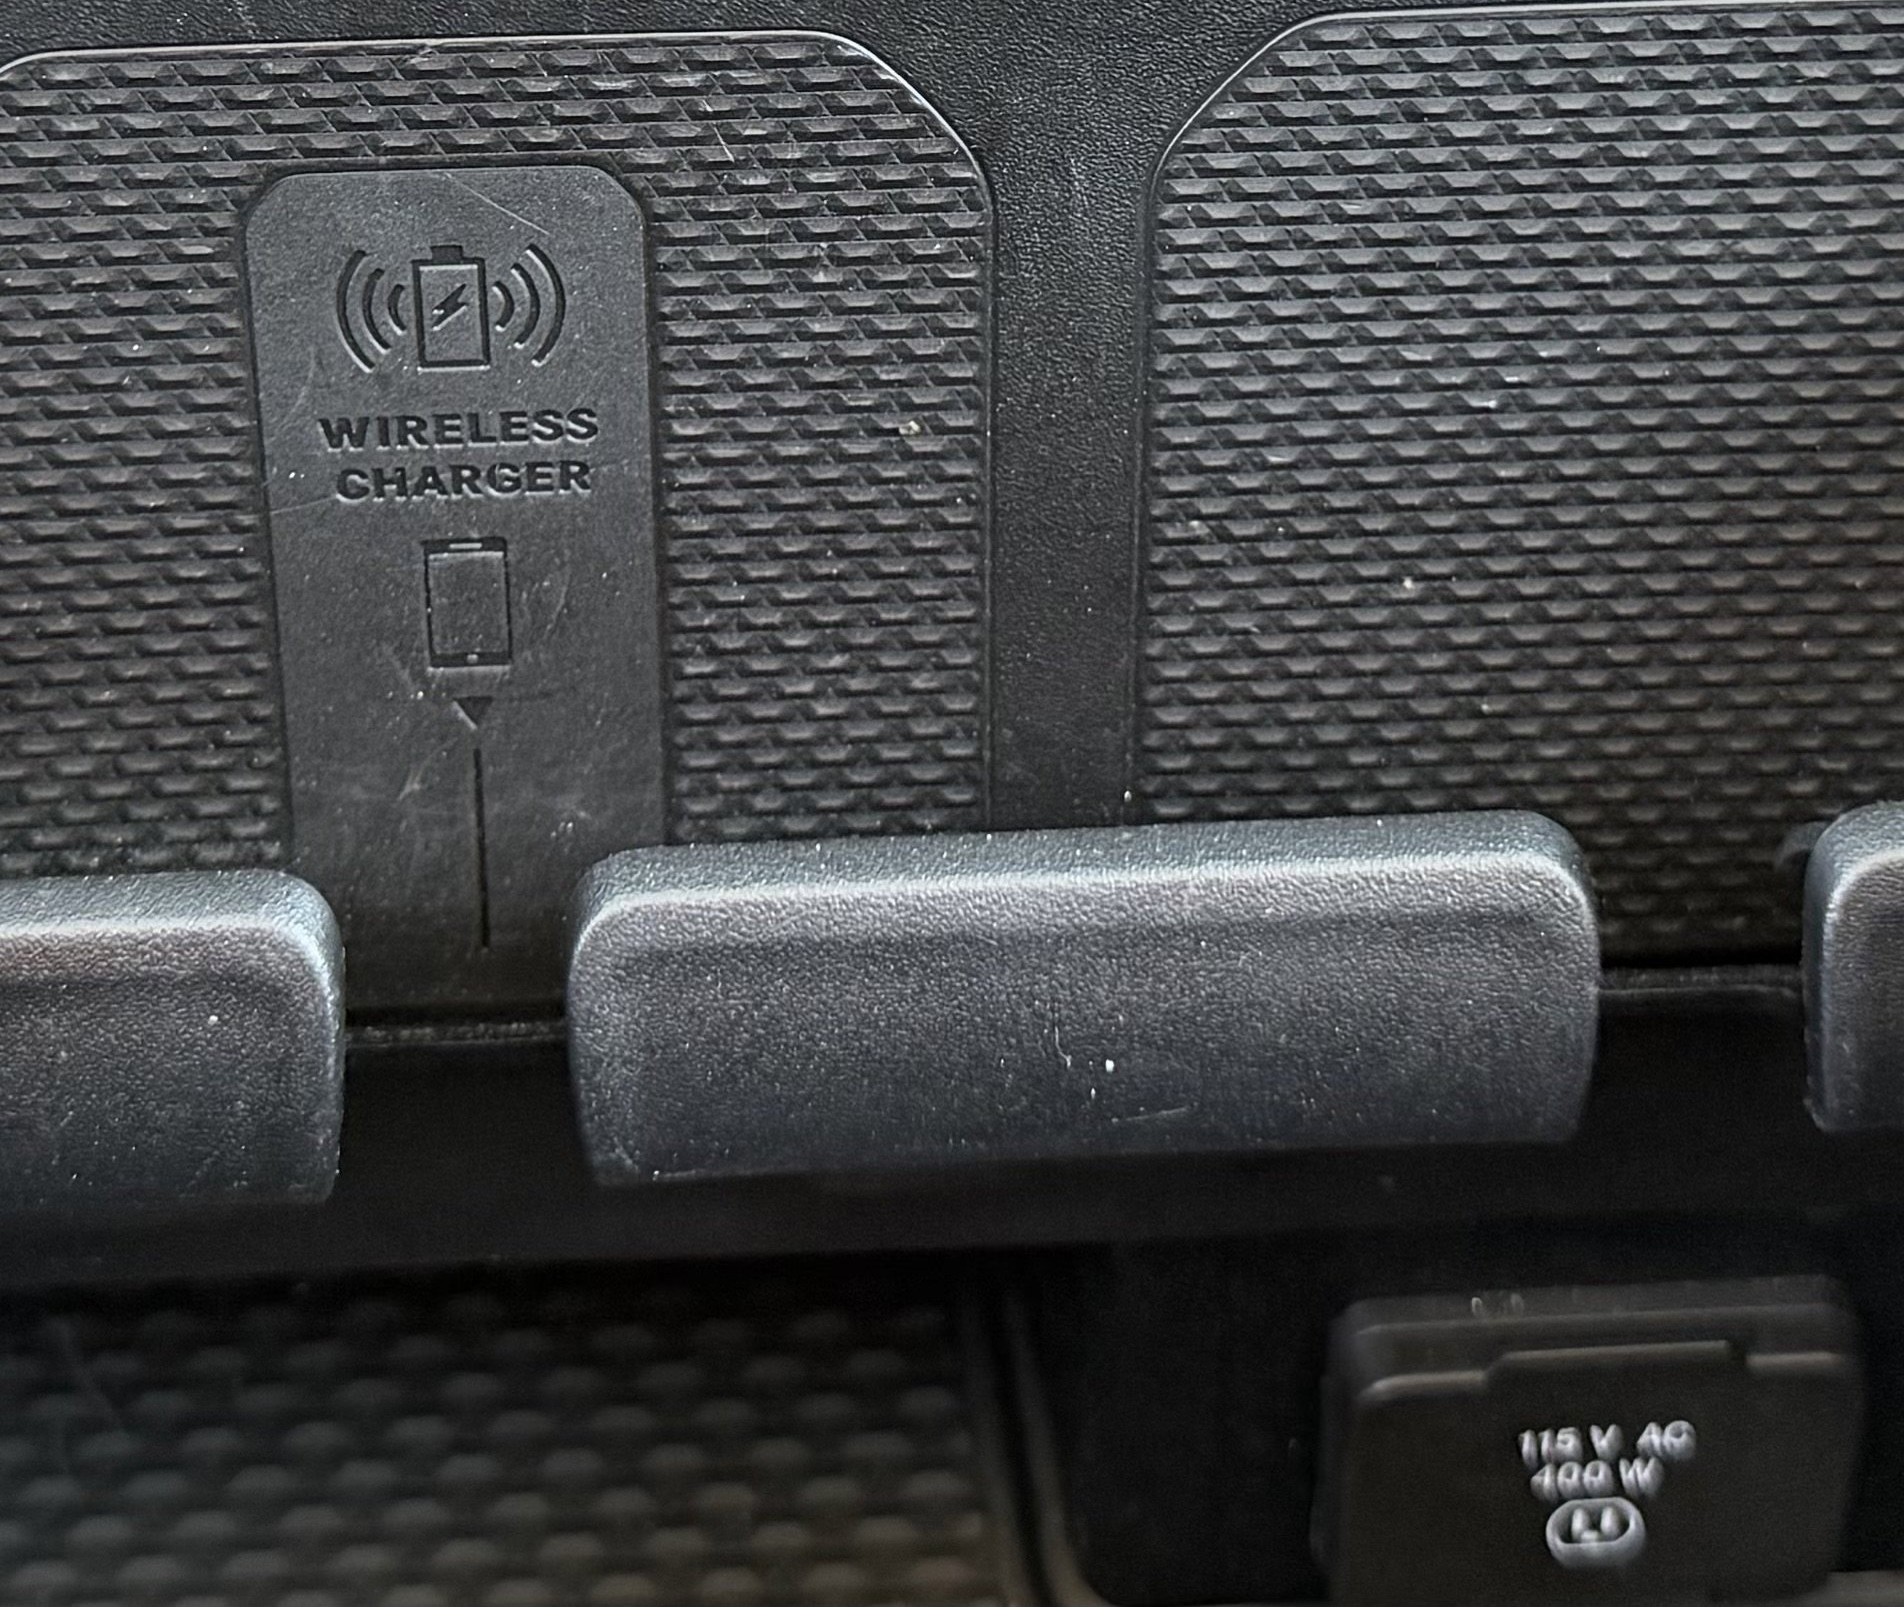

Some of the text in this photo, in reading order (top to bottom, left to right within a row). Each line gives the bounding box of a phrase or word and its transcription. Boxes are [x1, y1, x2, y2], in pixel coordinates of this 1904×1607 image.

[317, 407, 600, 452] WIRELESS
[334, 459, 595, 502] CHARGER
[1518, 1420, 1696, 1467] 115 V AC
[1530, 1456, 1665, 1503] 400 W
